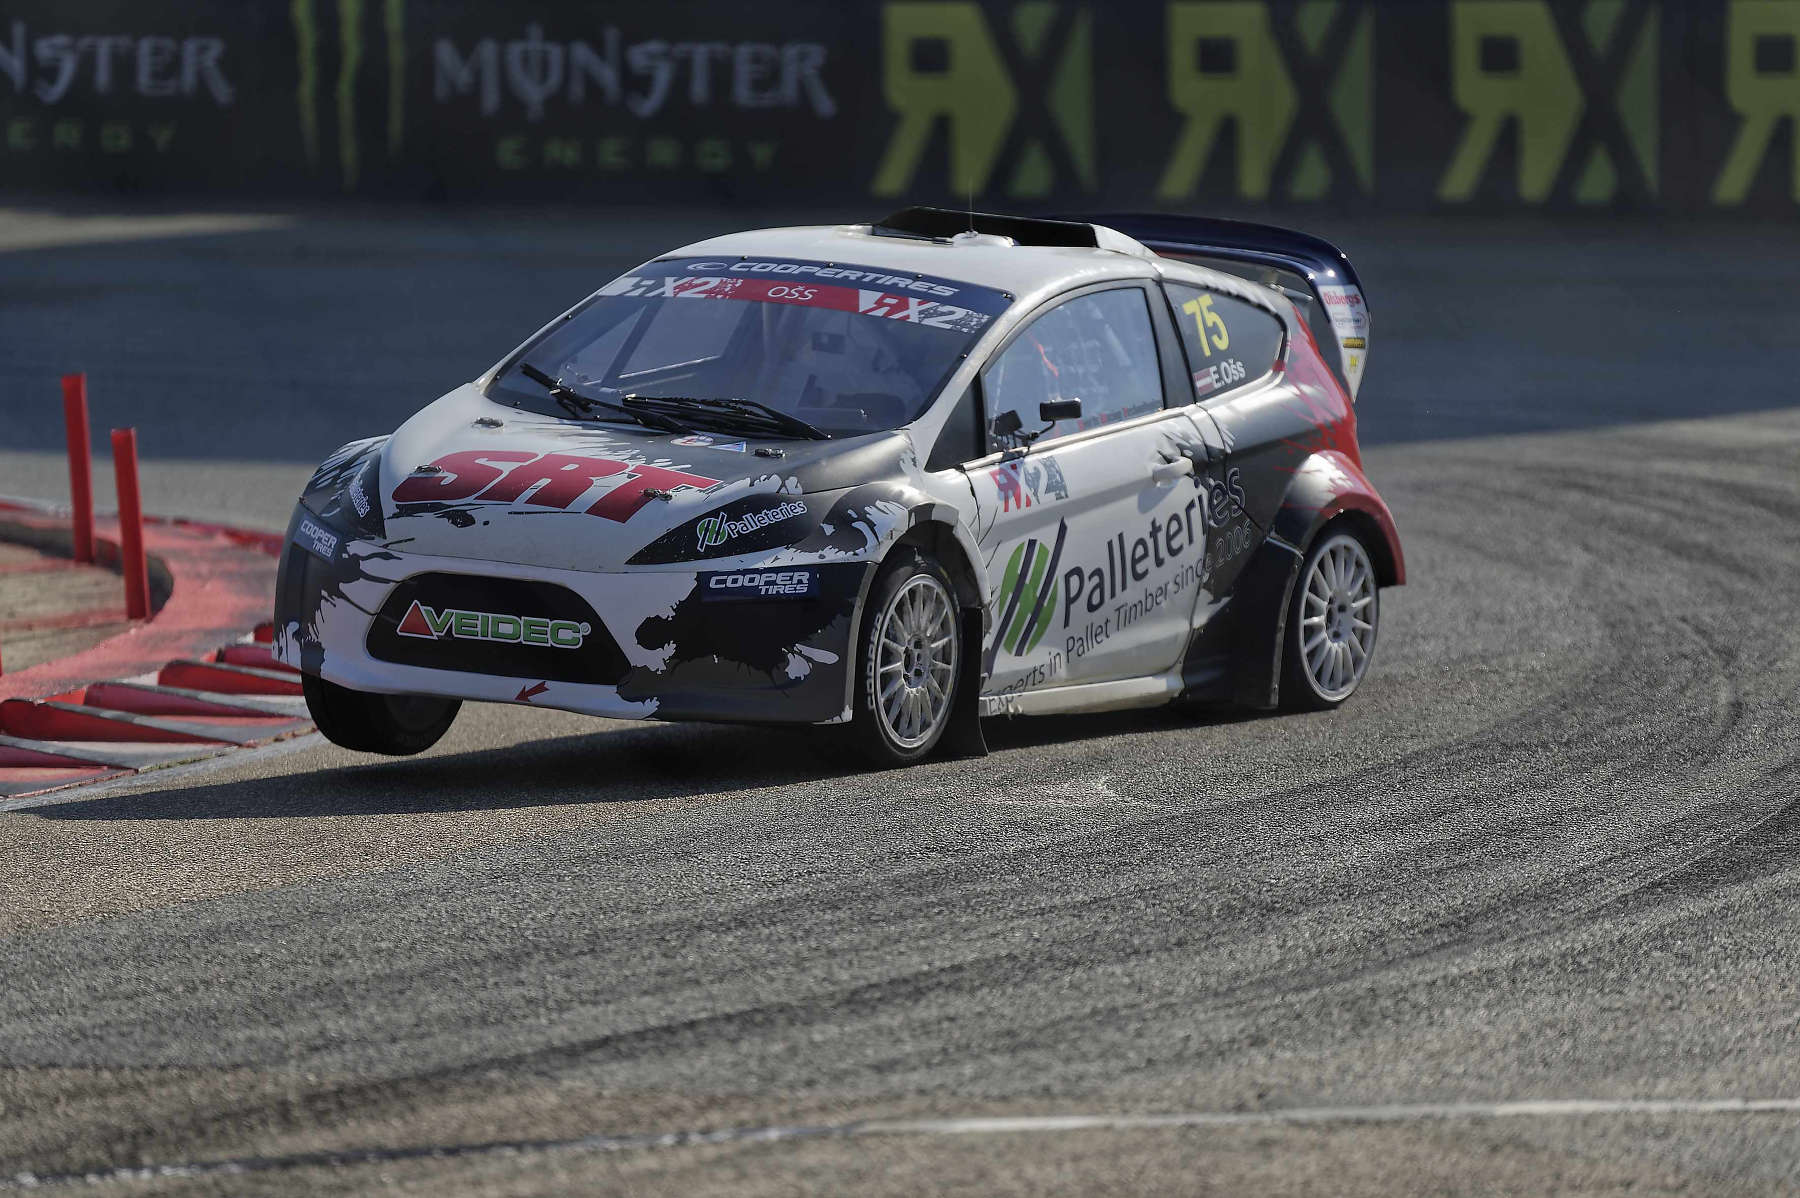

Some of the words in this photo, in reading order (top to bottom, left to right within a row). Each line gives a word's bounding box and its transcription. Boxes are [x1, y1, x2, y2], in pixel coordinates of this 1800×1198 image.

[432, 23, 838, 120] MONSTER
[495, 136, 783, 171] ENERGY
[1182, 293, 1230, 358] 75
[1211, 358, 1247, 388] E.Ošs
[391, 450, 724, 524] SRT
[301, 519, 338, 548] COOPER
[726, 501, 808, 538] Palleteries
[312, 540, 334, 557] TIRES
[1063, 468, 1246, 628] Palleteries
[709, 571, 810, 589] COOPER
[758, 584, 809, 595] TIRES
[1048, 651, 1062, 677] in
[1066, 617, 1111, 664] Pallet
[1113, 582, 1171, 632] Timber
[1173, 552, 1213, 601] since
